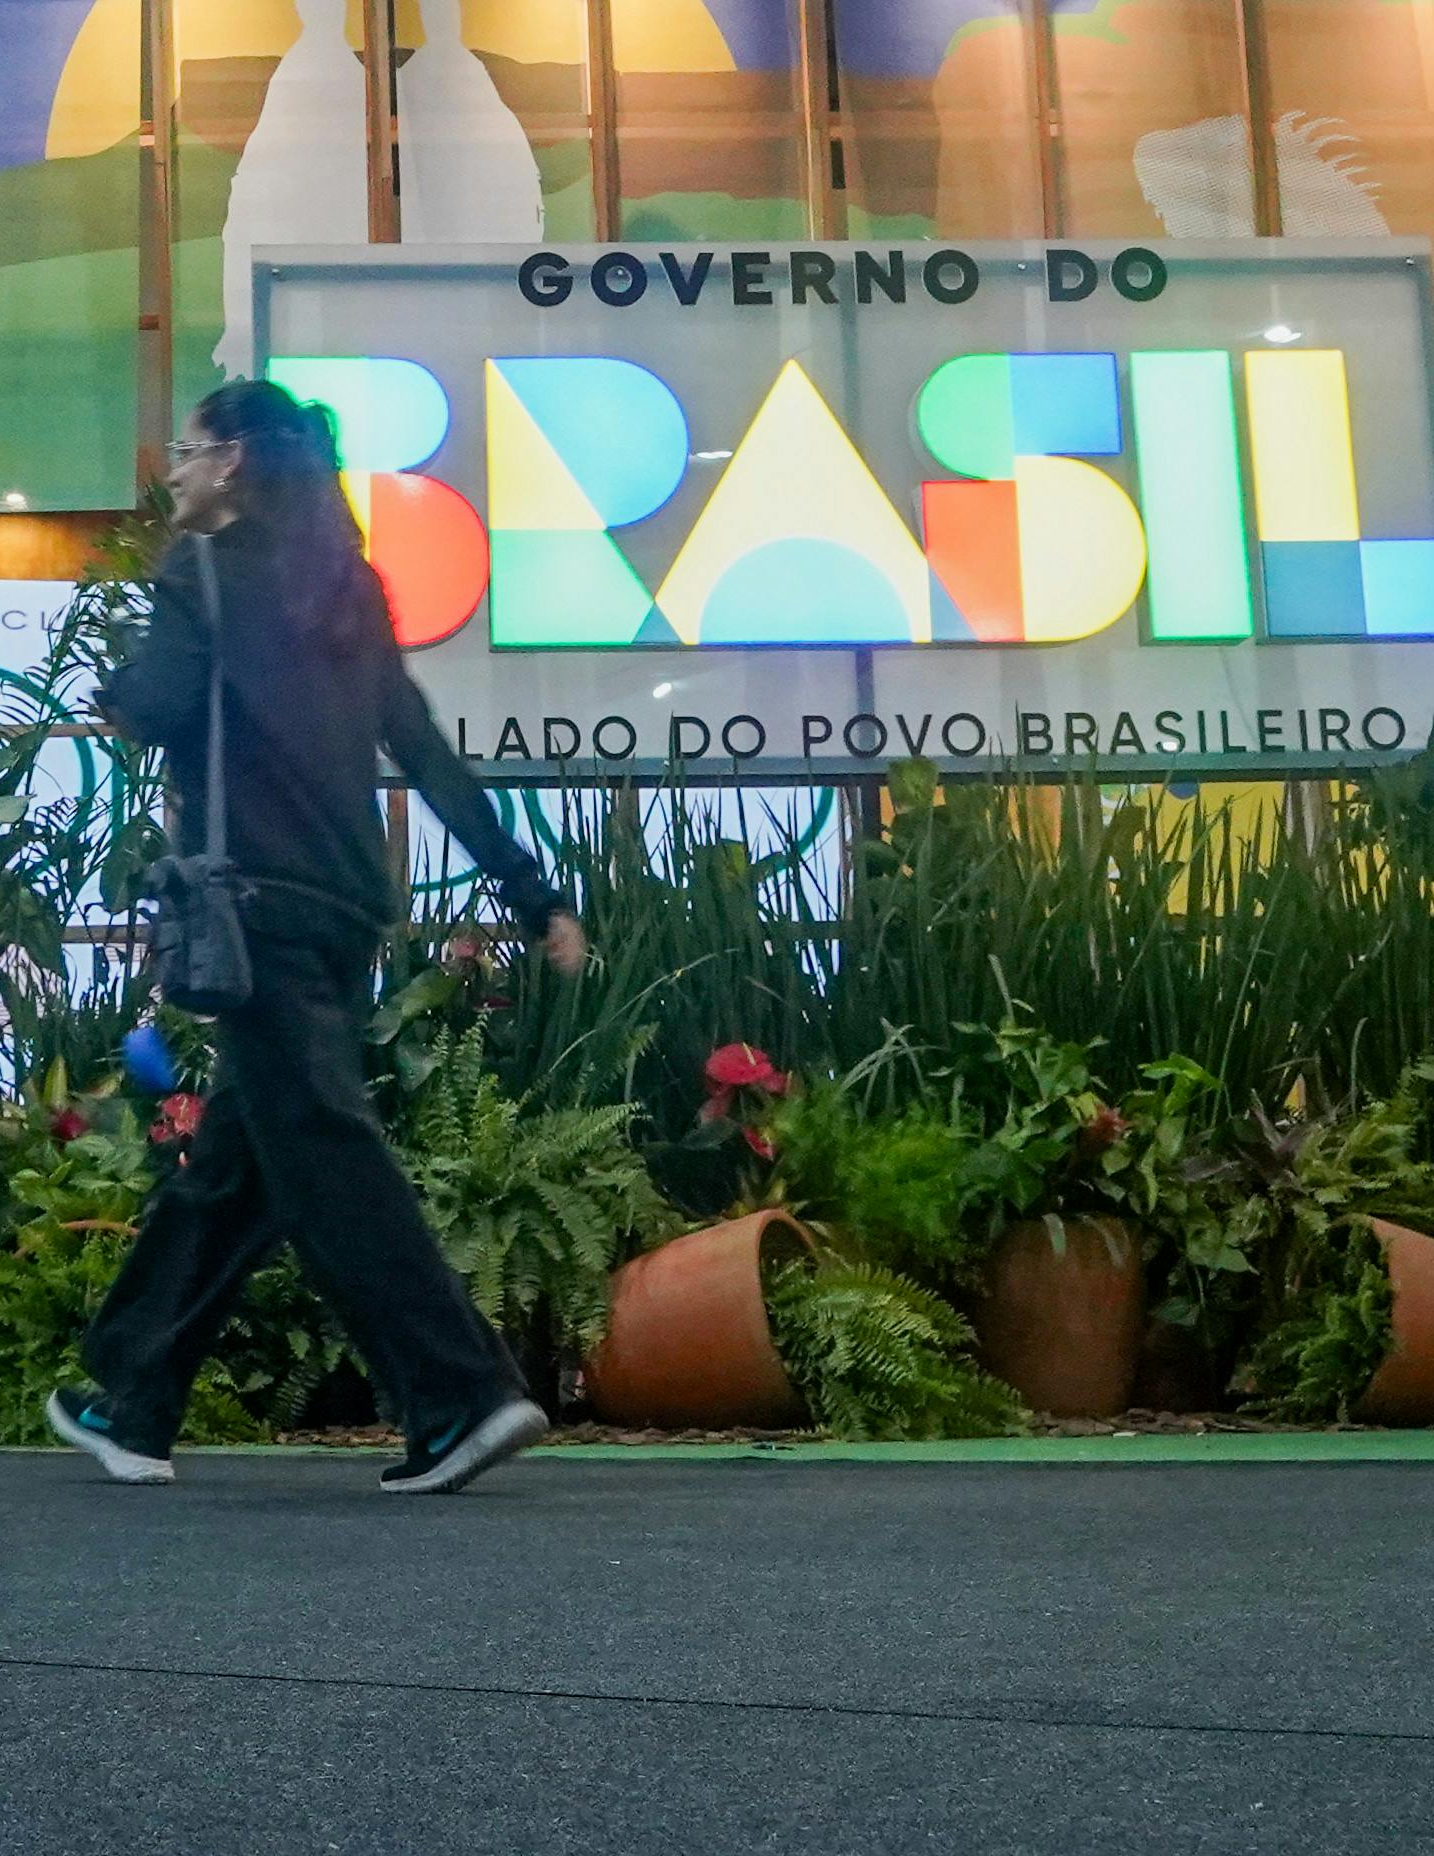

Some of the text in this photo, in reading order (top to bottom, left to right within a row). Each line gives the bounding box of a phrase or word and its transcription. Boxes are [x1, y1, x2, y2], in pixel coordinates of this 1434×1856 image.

[518, 246, 1168, 308] GOVERNO DO
[457, 706, 1407, 762] LADO DO POVO BRASILEIRO
